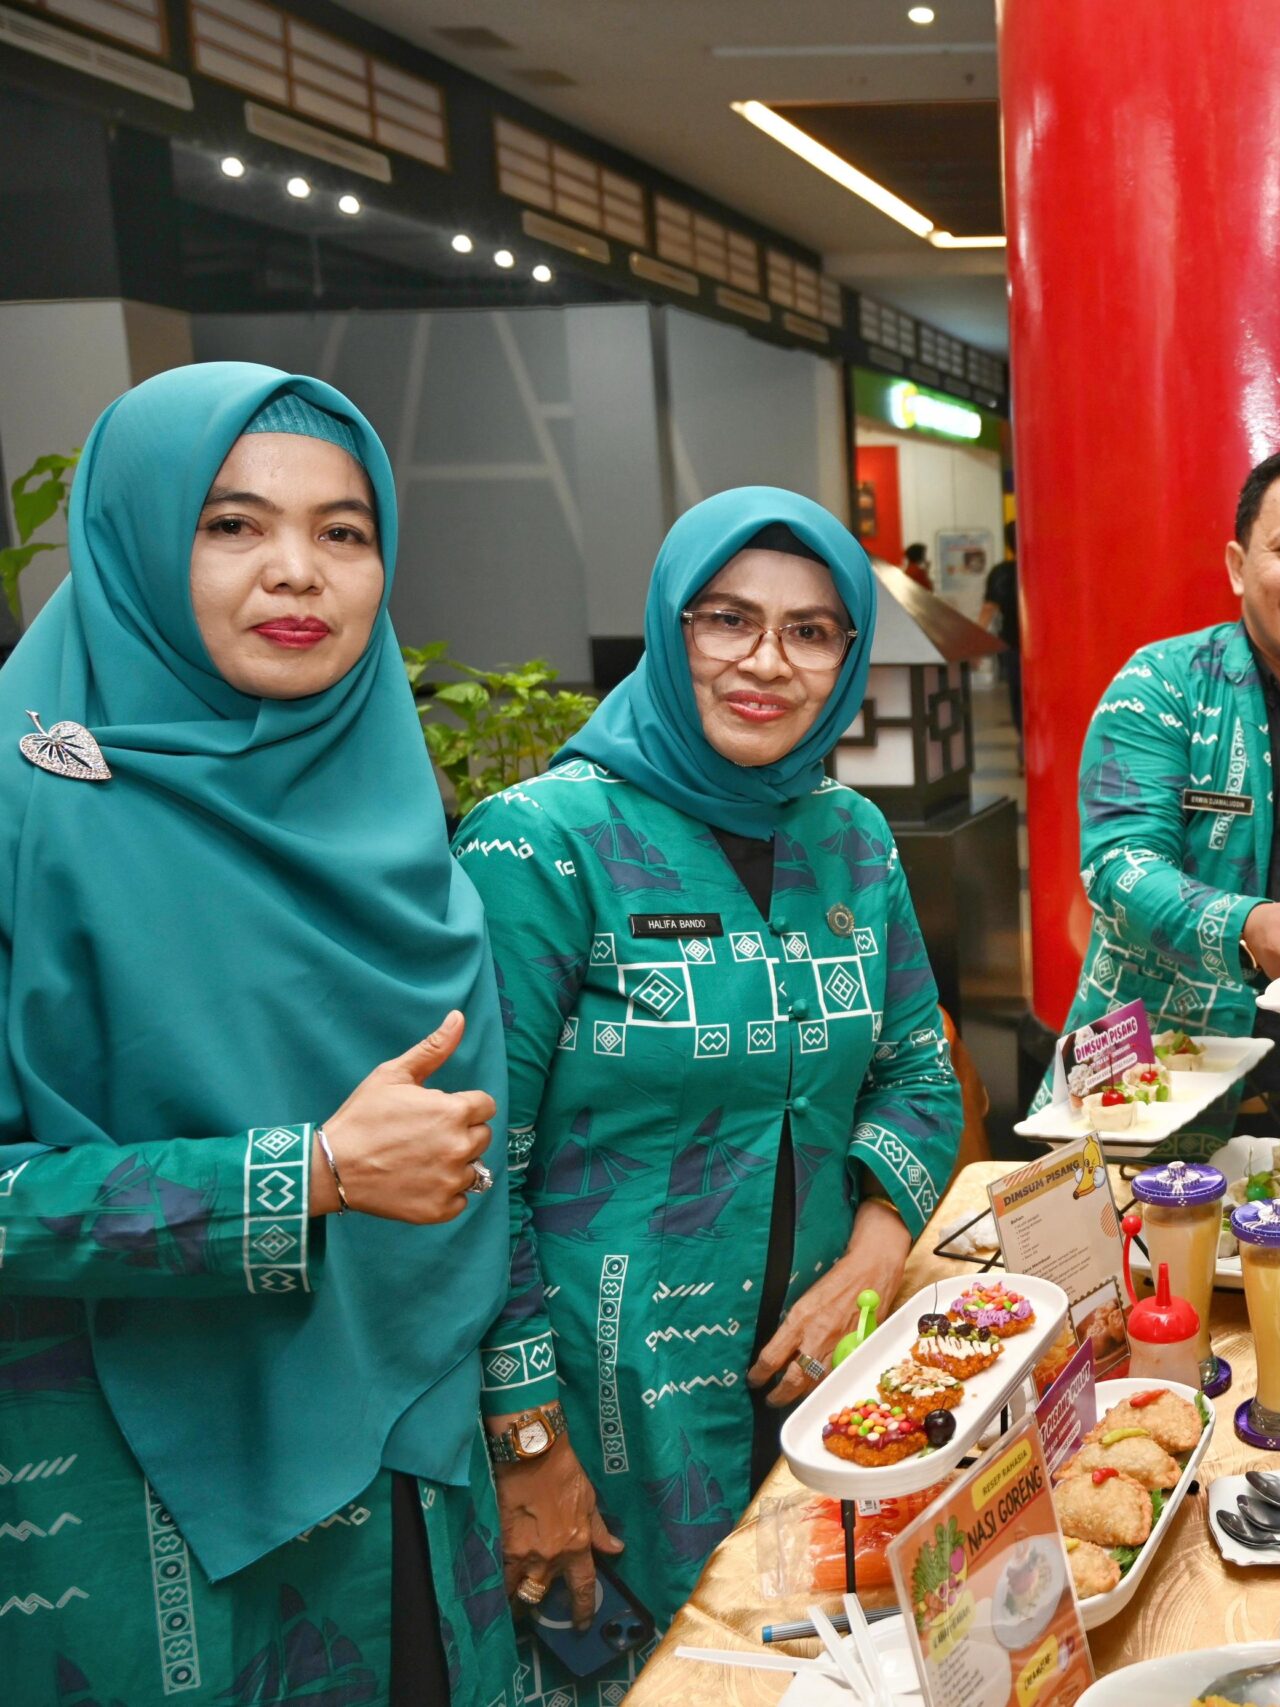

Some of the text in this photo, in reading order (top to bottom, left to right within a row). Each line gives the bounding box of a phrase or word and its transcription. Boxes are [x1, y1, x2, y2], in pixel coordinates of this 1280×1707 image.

[648, 919, 706, 929] HALIFA BANDO
[1075, 1033, 1109, 1061] DIMSUM
[1109, 1018, 1137, 1043] PISANG
[1003, 1160, 1080, 1207] DIMSUM PISANG
[1046, 1389, 1071, 1437] PISANG
[982, 1473, 1001, 1496] RESEP
[1002, 1449, 1028, 1477] RAHASIA
[967, 1465, 1042, 1557] NASI GORENG
